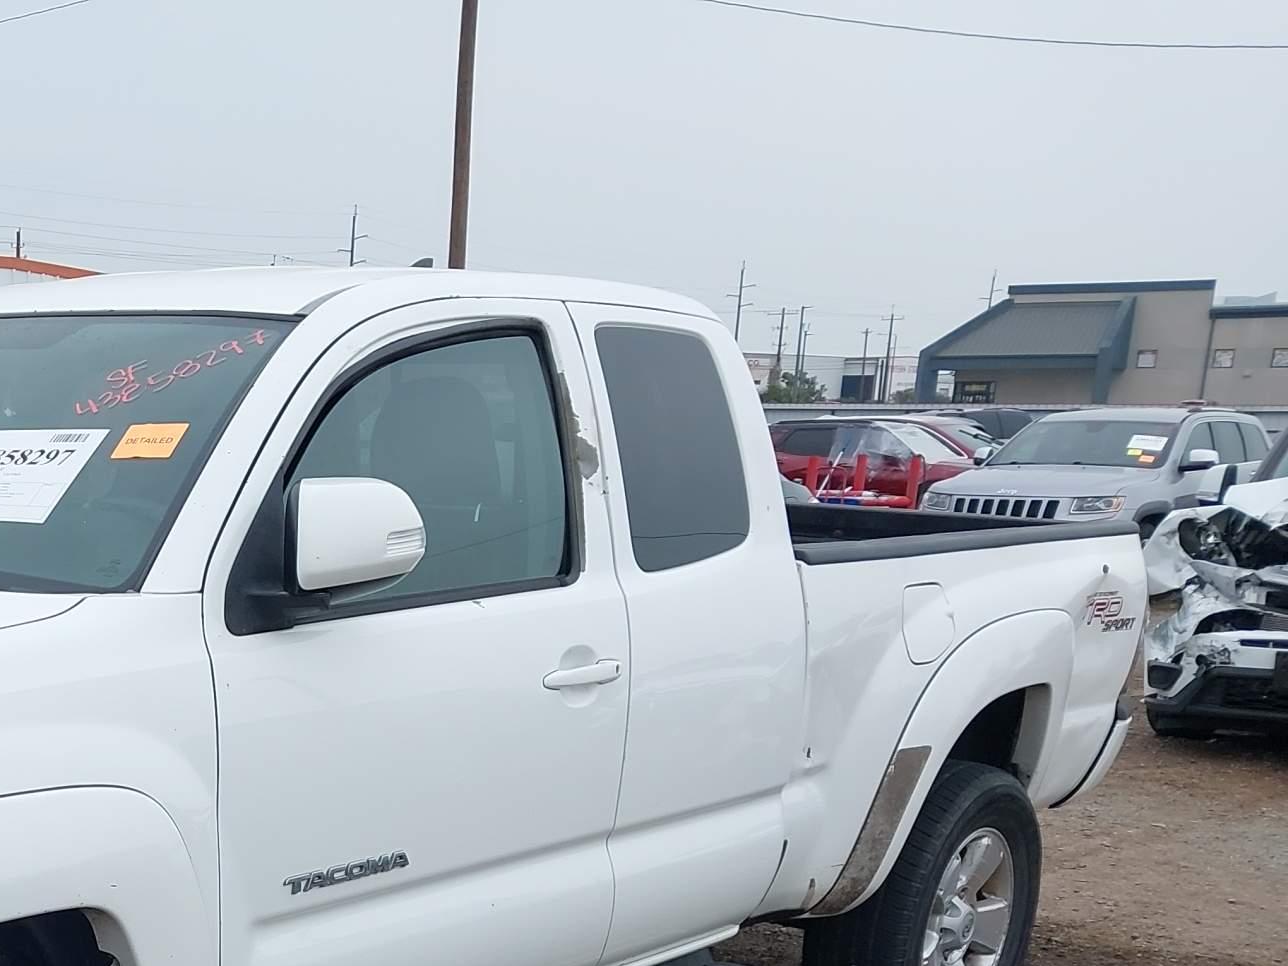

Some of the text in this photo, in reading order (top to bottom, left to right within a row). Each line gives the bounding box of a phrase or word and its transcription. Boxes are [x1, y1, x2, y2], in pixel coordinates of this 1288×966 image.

[125, 436, 174, 445] DETAILED
[1101, 617, 1136, 633] SPORT
[283, 850, 410, 895] TACOMA
